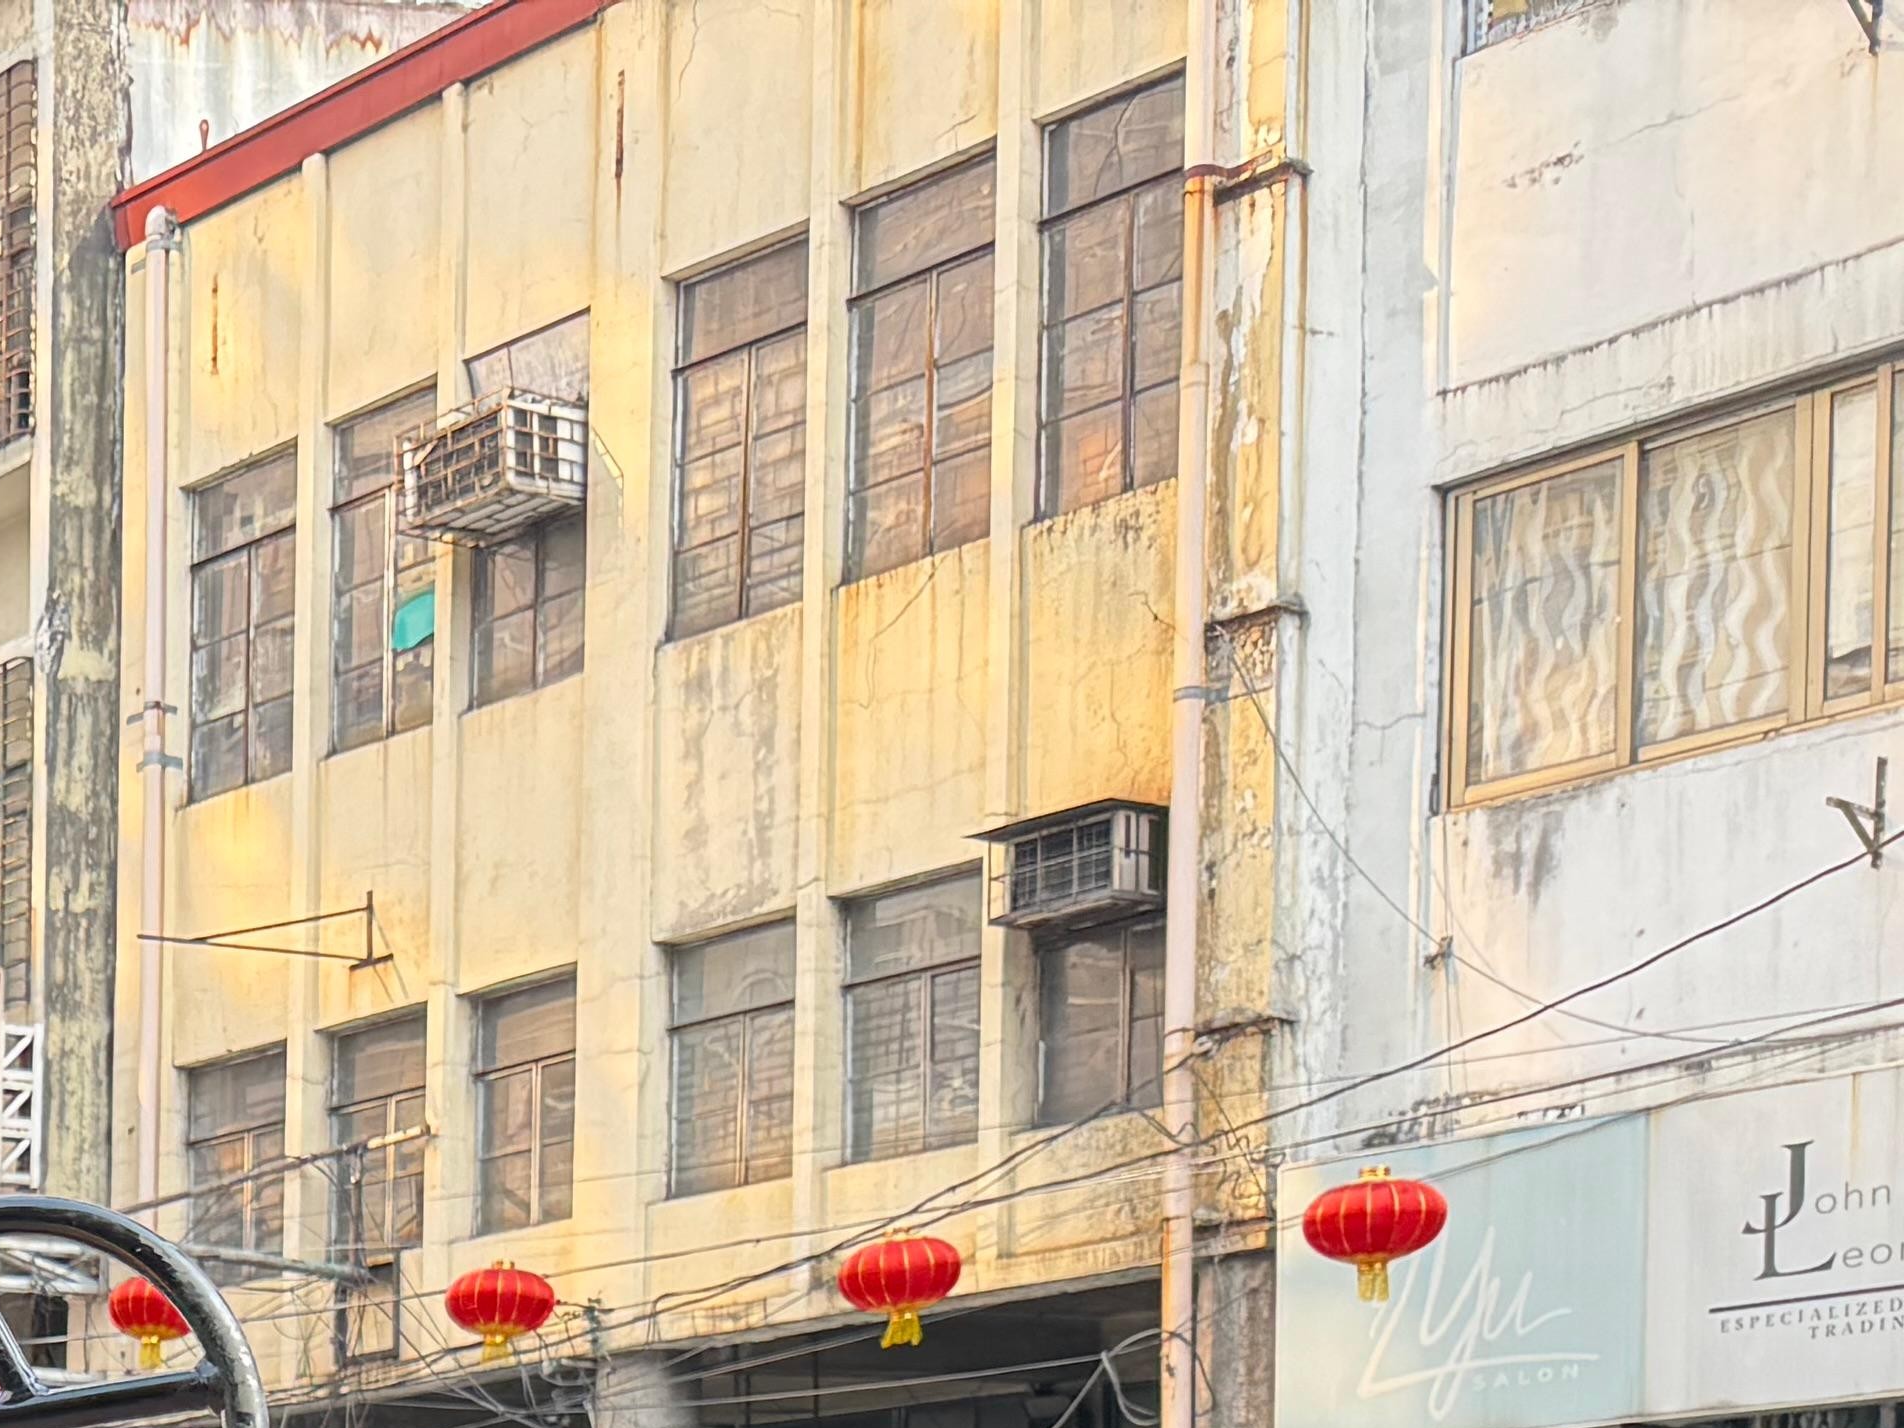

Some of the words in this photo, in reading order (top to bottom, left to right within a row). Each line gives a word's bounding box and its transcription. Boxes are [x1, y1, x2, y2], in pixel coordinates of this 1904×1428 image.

[1741, 1139, 1891, 1234] John
[1753, 1191, 1904, 1281] Leo
[1720, 1297, 1904, 1334] ESPECIALIZED
[1472, 1364, 1580, 1392] SALON
